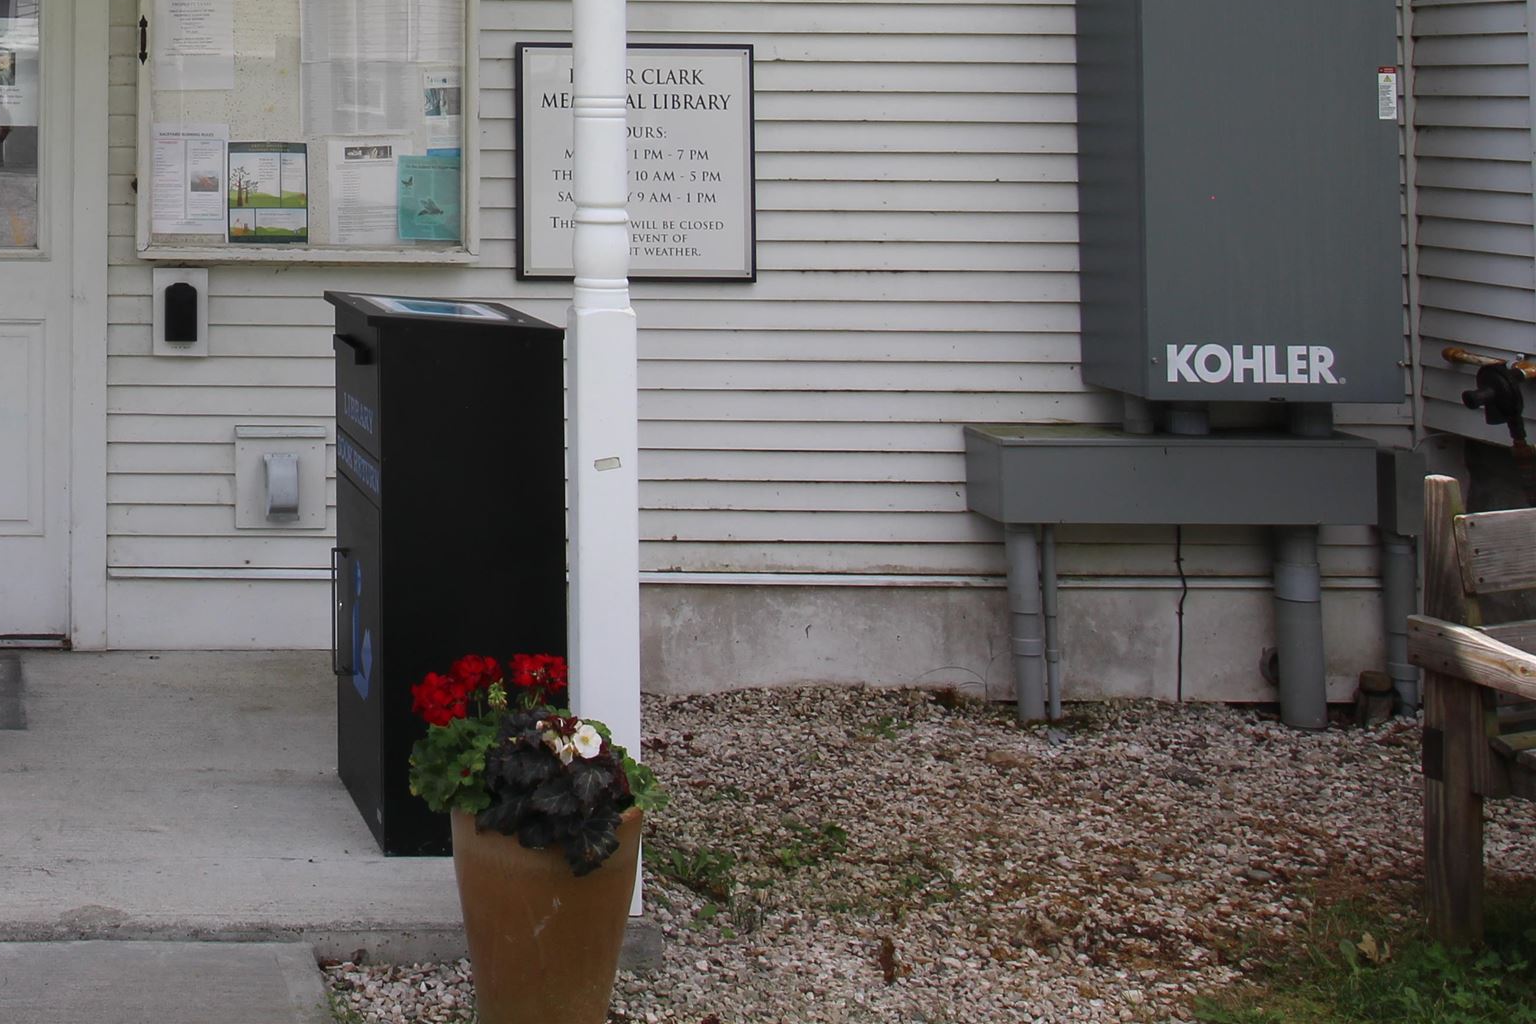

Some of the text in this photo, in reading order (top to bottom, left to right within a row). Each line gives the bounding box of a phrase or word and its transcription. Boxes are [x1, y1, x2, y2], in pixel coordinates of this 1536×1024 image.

[641, 69, 705, 86] CLARK
[541, 92, 732, 110] MEAL LIBRARY
[633, 149, 639, 160] 1
[644, 149, 663, 160] PM
[677, 149, 684, 160] 7
[689, 149, 709, 161] PM
[635, 171, 648, 182] 10
[653, 171, 675, 182] AM
[689, 171, 697, 182] 5
[702, 171, 722, 182] PM
[637, 192, 645, 203] 9
[649, 192, 672, 203] AM
[686, 193, 691, 203] 1
[697, 193, 717, 204] PM
[631, 220, 657, 230] WILL
[662, 221, 675, 230] BE
[679, 221, 724, 231] CLOSED
[632, 234, 688, 243] EVENT OF
[645, 247, 702, 257] WEATHER.
[1166, 343, 1339, 384] KOHLER
[343, 391, 375, 435] LIBRARY
